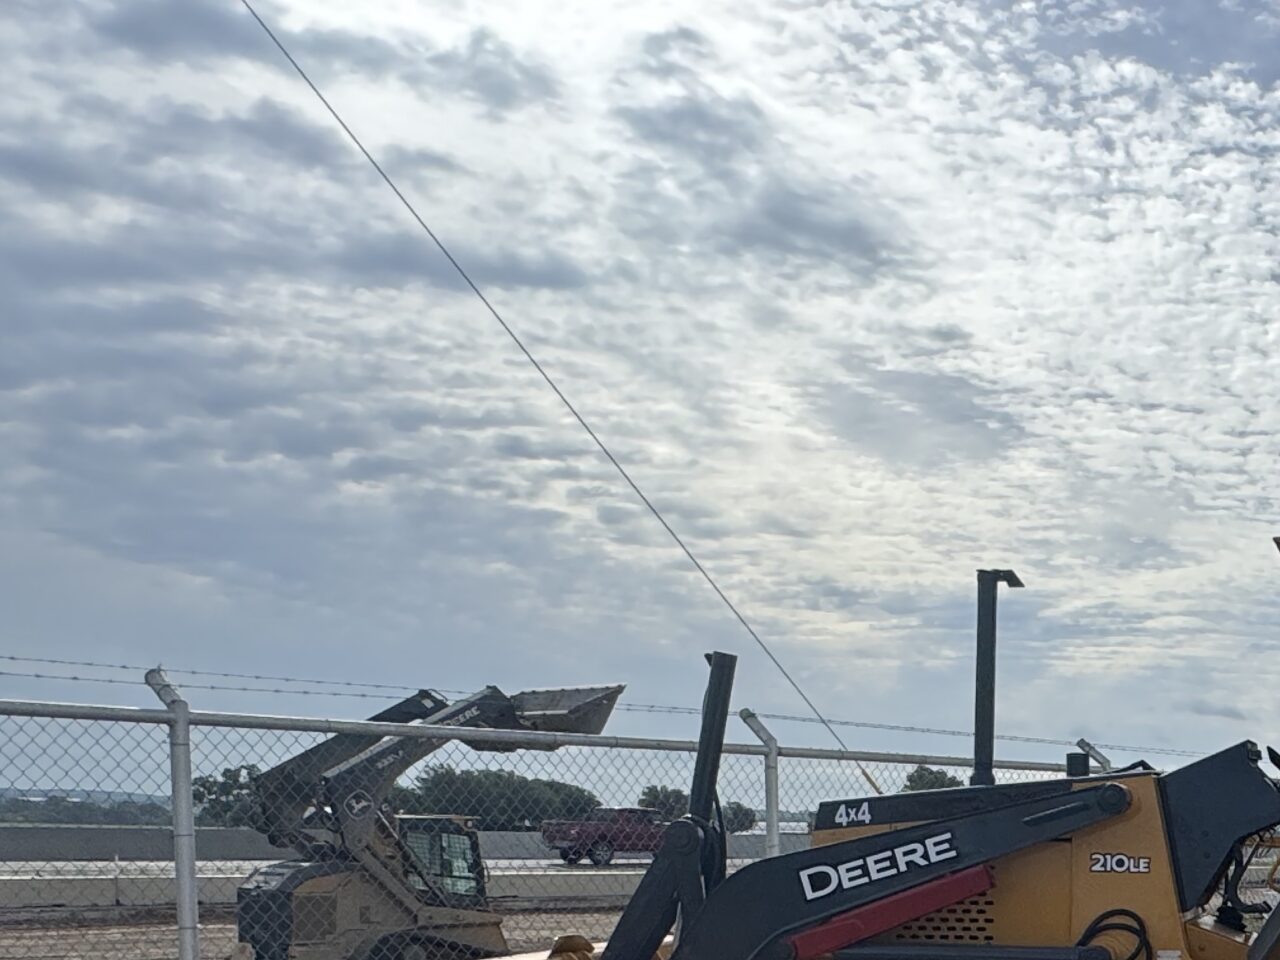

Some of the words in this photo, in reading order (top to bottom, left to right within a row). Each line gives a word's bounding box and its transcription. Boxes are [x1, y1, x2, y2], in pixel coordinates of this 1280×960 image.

[834, 802, 872, 826] 4x4
[799, 832, 957, 900] DEERE
[1090, 853, 1150, 873] 210LE
